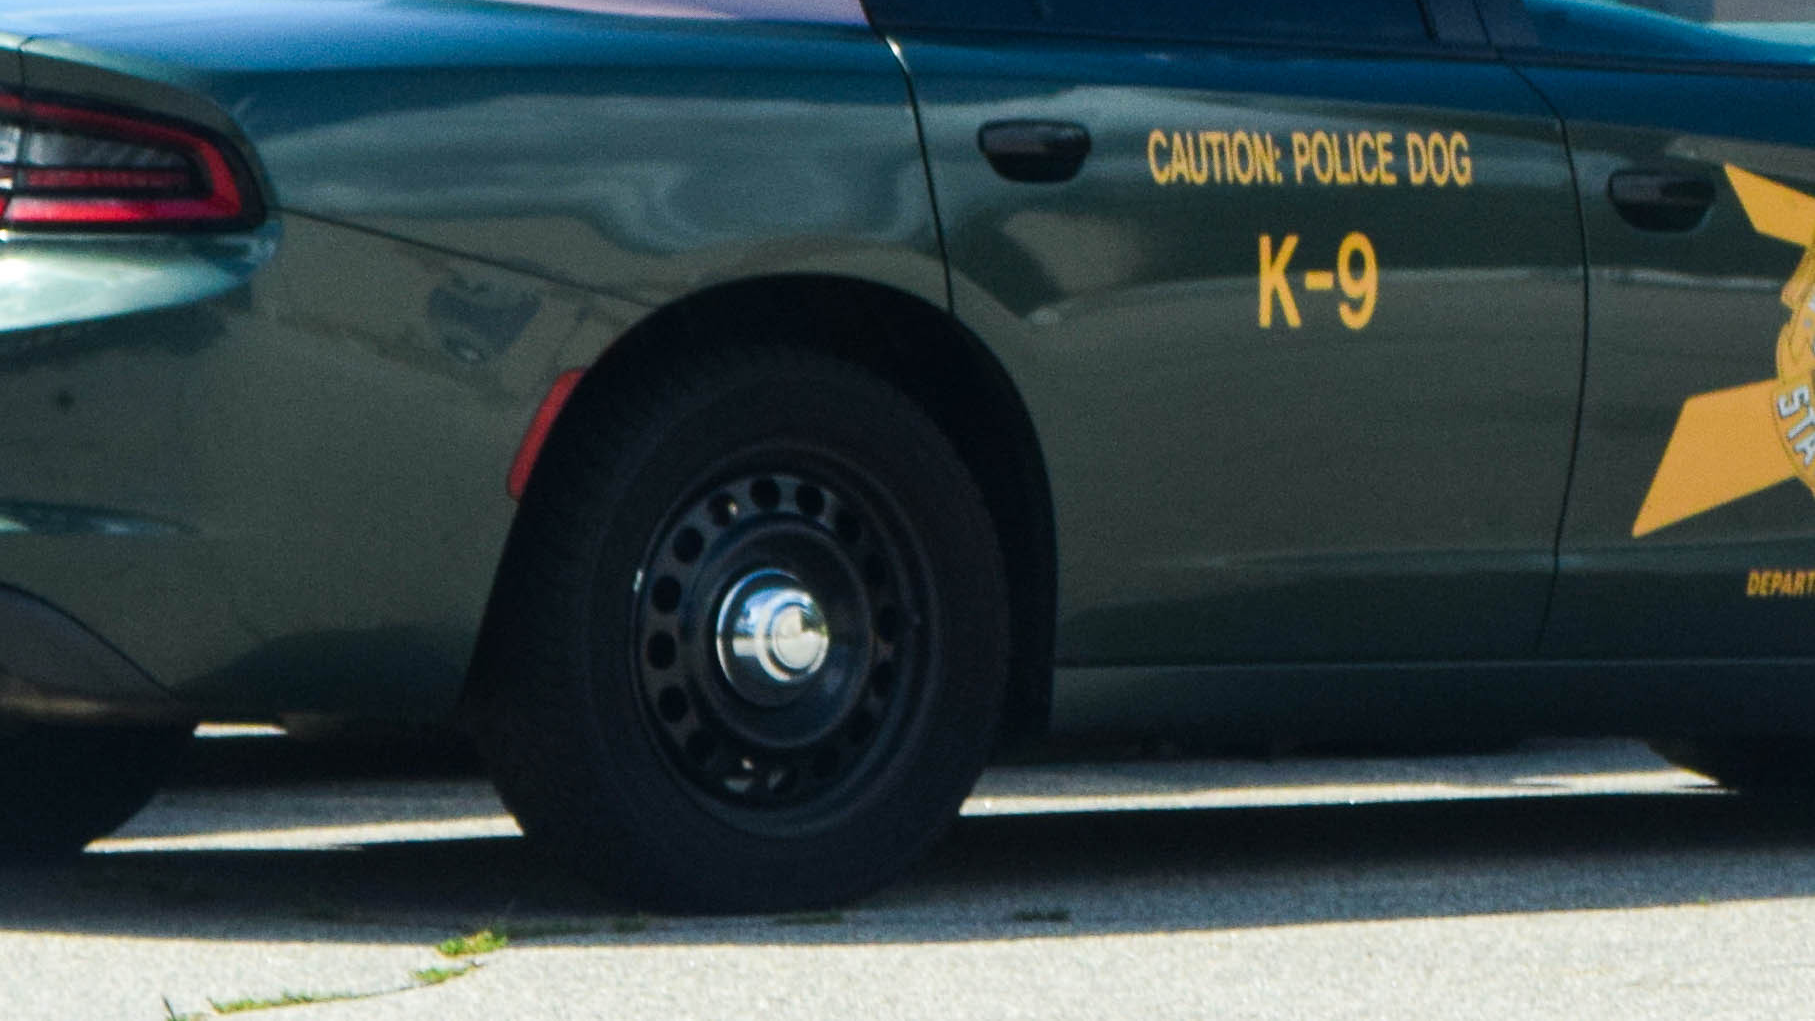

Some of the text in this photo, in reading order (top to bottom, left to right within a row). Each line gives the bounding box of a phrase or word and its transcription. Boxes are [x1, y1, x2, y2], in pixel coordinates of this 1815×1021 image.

[1147, 129, 1473, 187] CAUTION: POLICE DOG
[1258, 232, 1379, 330] K-9
